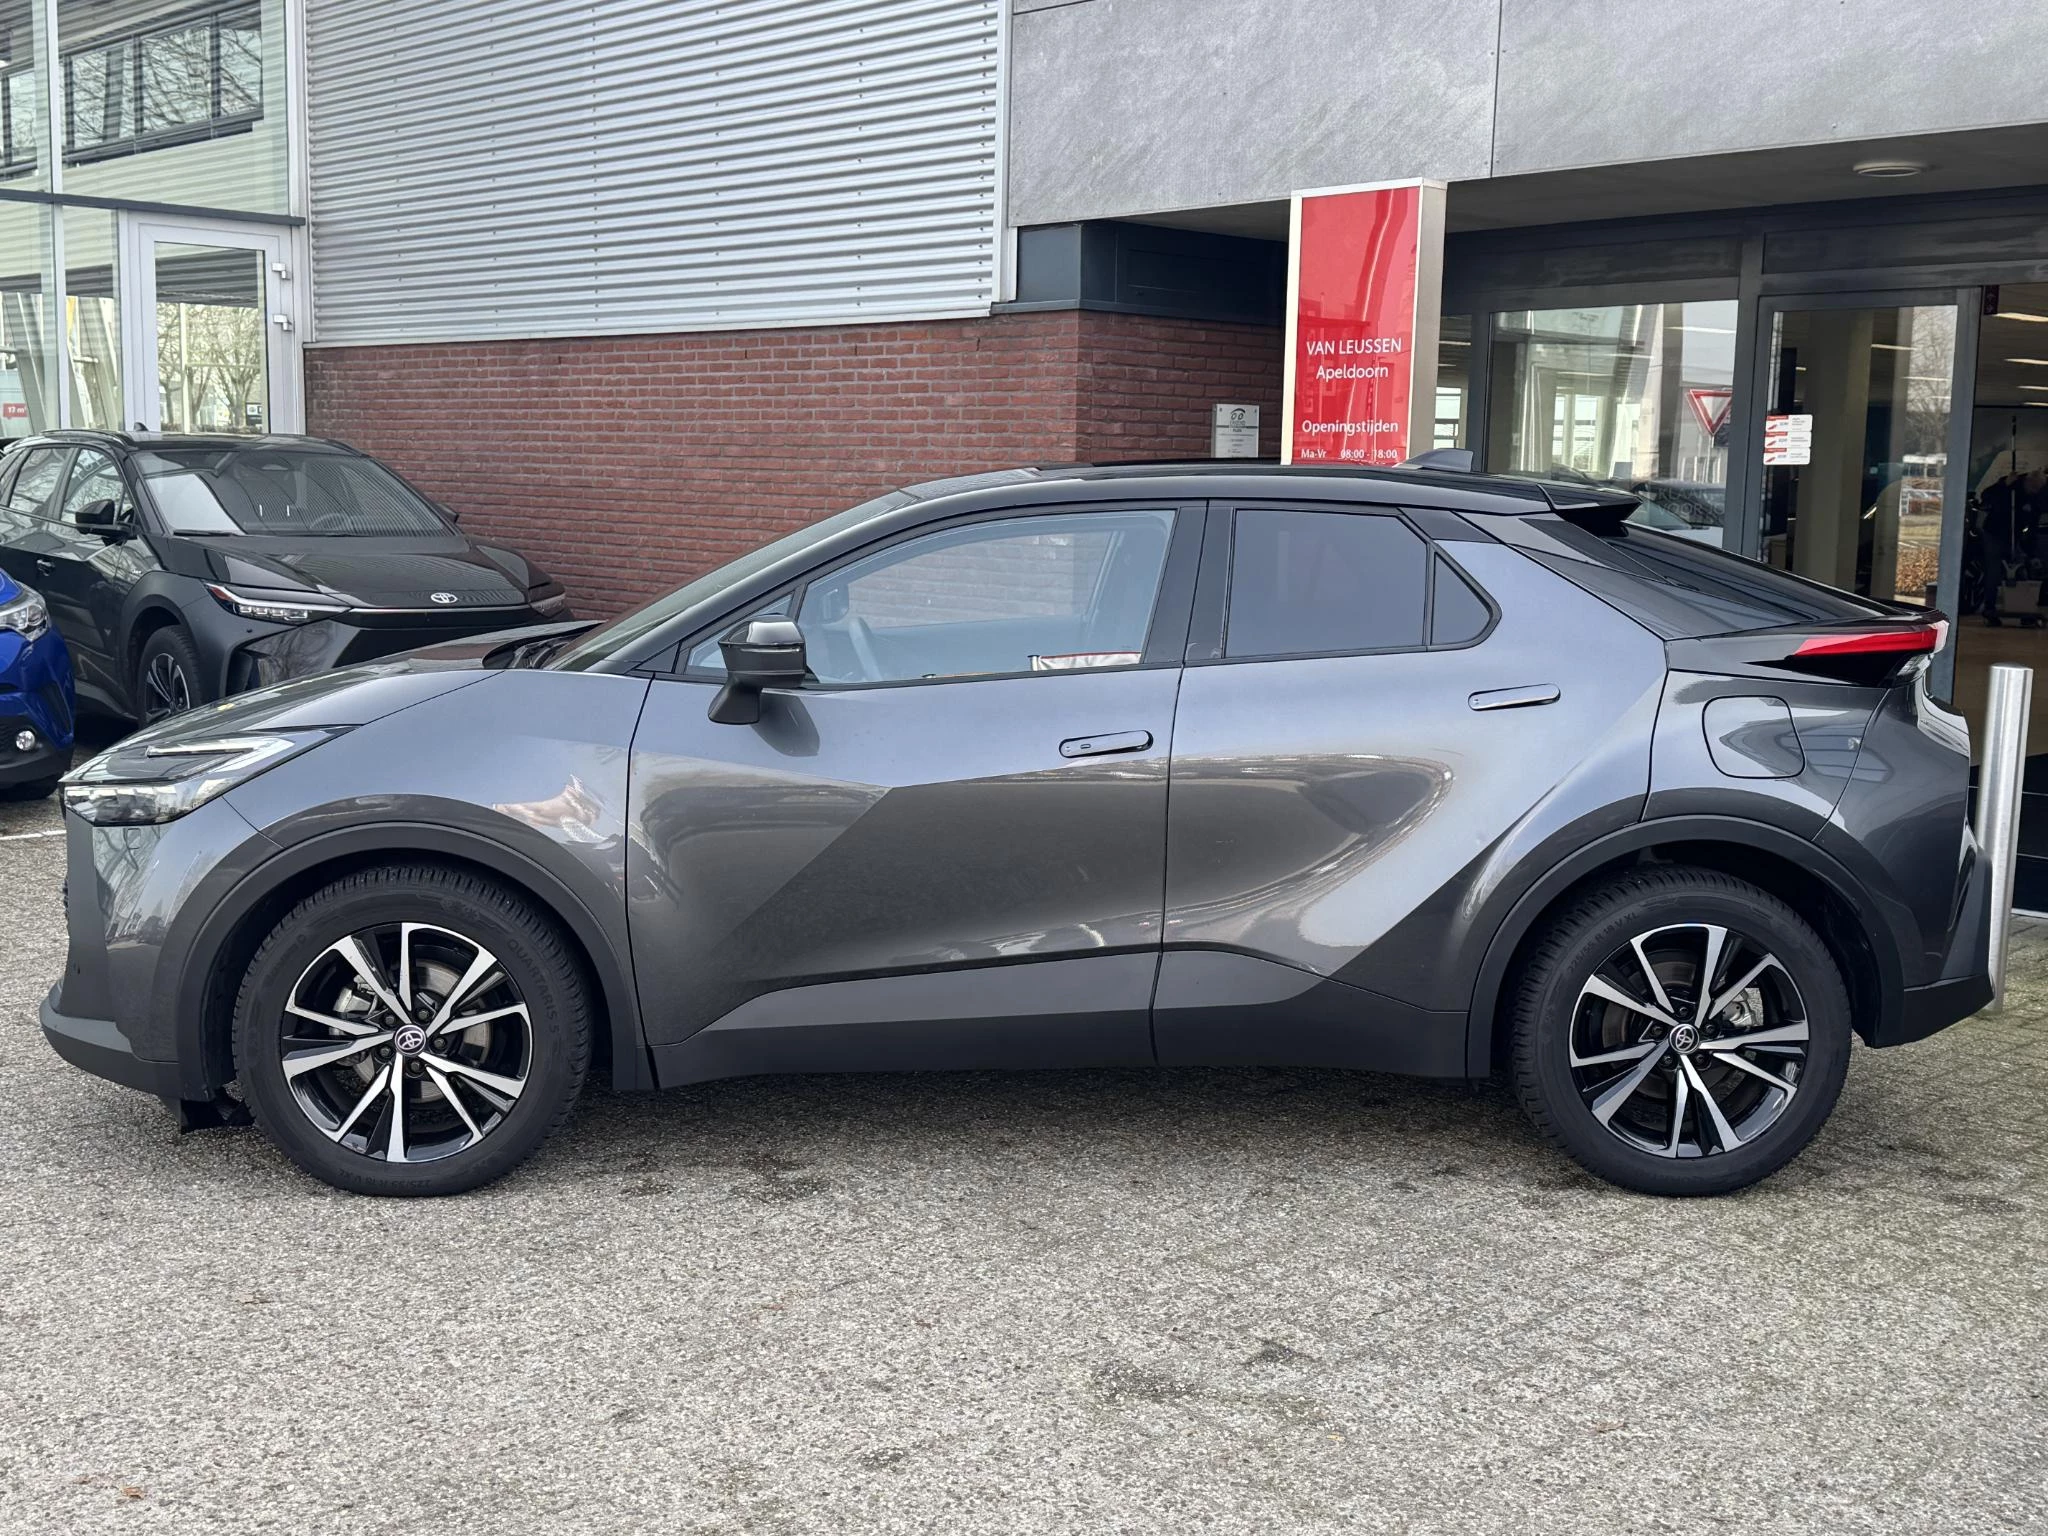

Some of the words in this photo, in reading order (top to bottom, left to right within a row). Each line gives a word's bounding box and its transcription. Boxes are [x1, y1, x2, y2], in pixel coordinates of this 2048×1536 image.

[1306, 340, 1335, 355] VAN
[1339, 338, 1402, 354] LEUSSEN
[1316, 363, 1389, 382] Apeldoorn
[1302, 419, 1399, 436] Openingstijden
[1301, 449, 1327, 459] Ma-Vr
[1340, 448, 1365, 459] 08:00
[507, 939, 557, 1020] QUARTARIS
